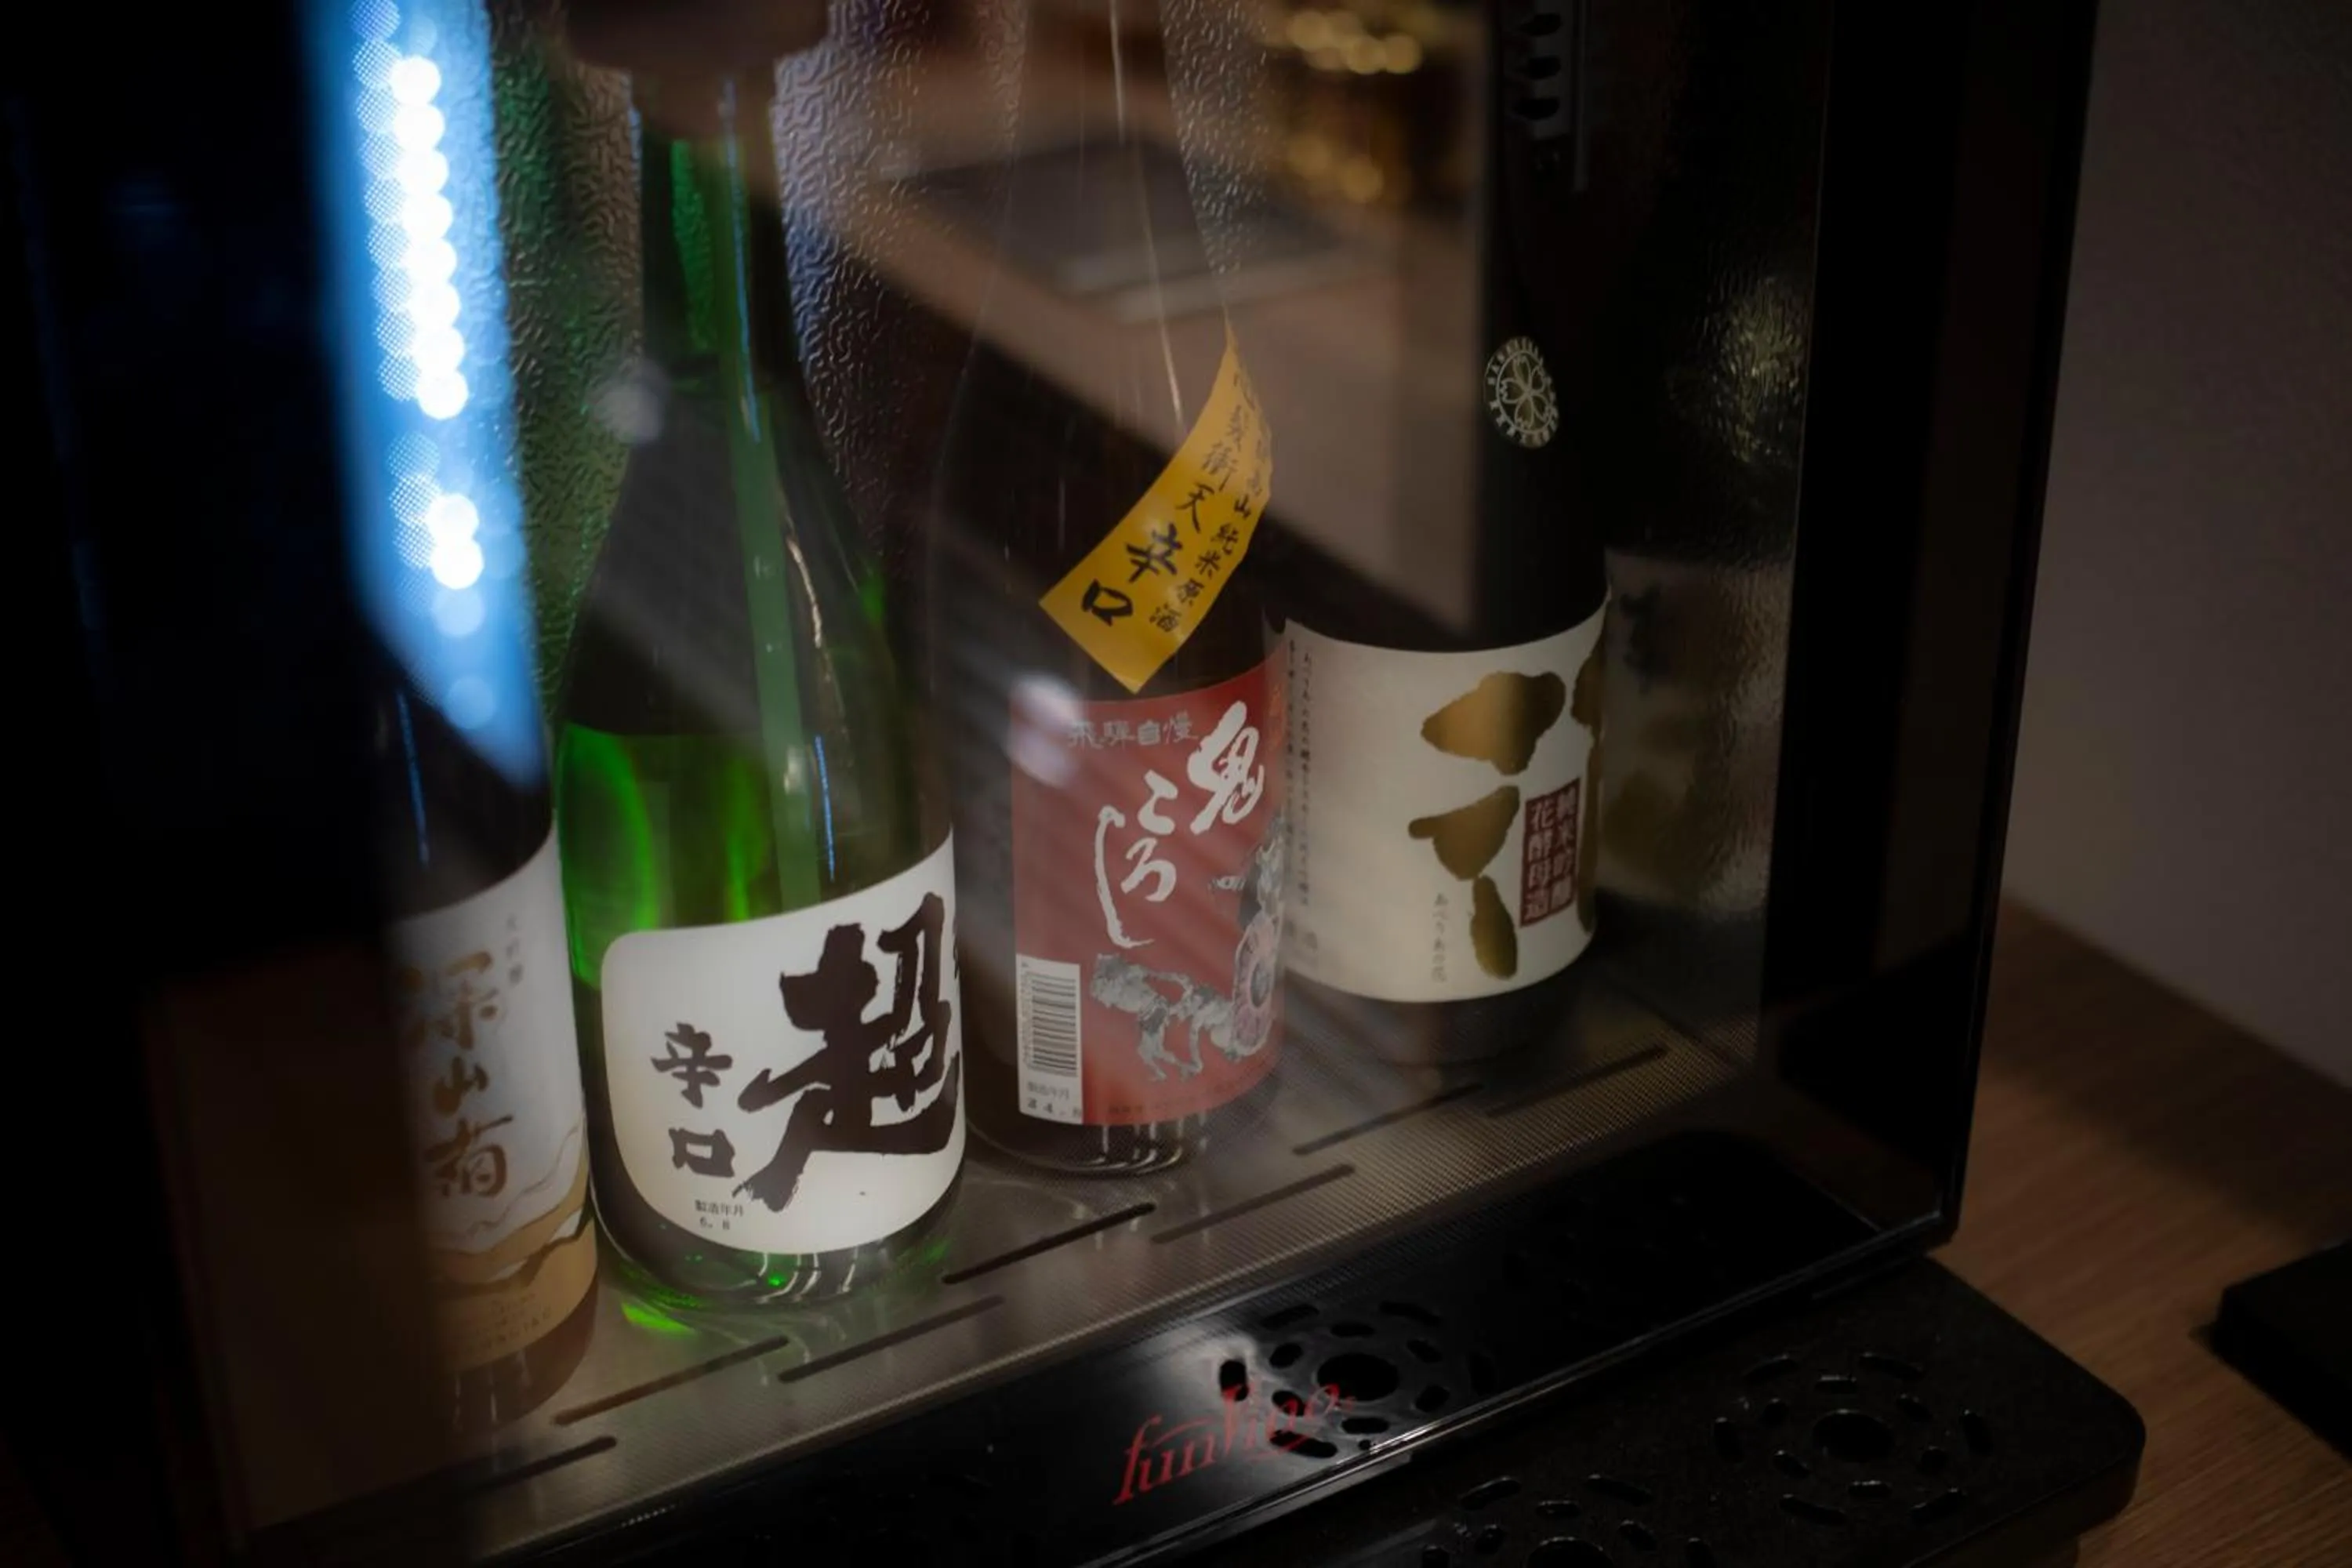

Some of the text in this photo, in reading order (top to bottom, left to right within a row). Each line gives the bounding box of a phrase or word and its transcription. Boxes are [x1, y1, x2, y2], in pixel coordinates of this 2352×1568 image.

[1094, 701, 1264, 949] 鬼ころし
[651, 1022, 735, 1177] 辛口
[732, 892, 959, 1212] 超
